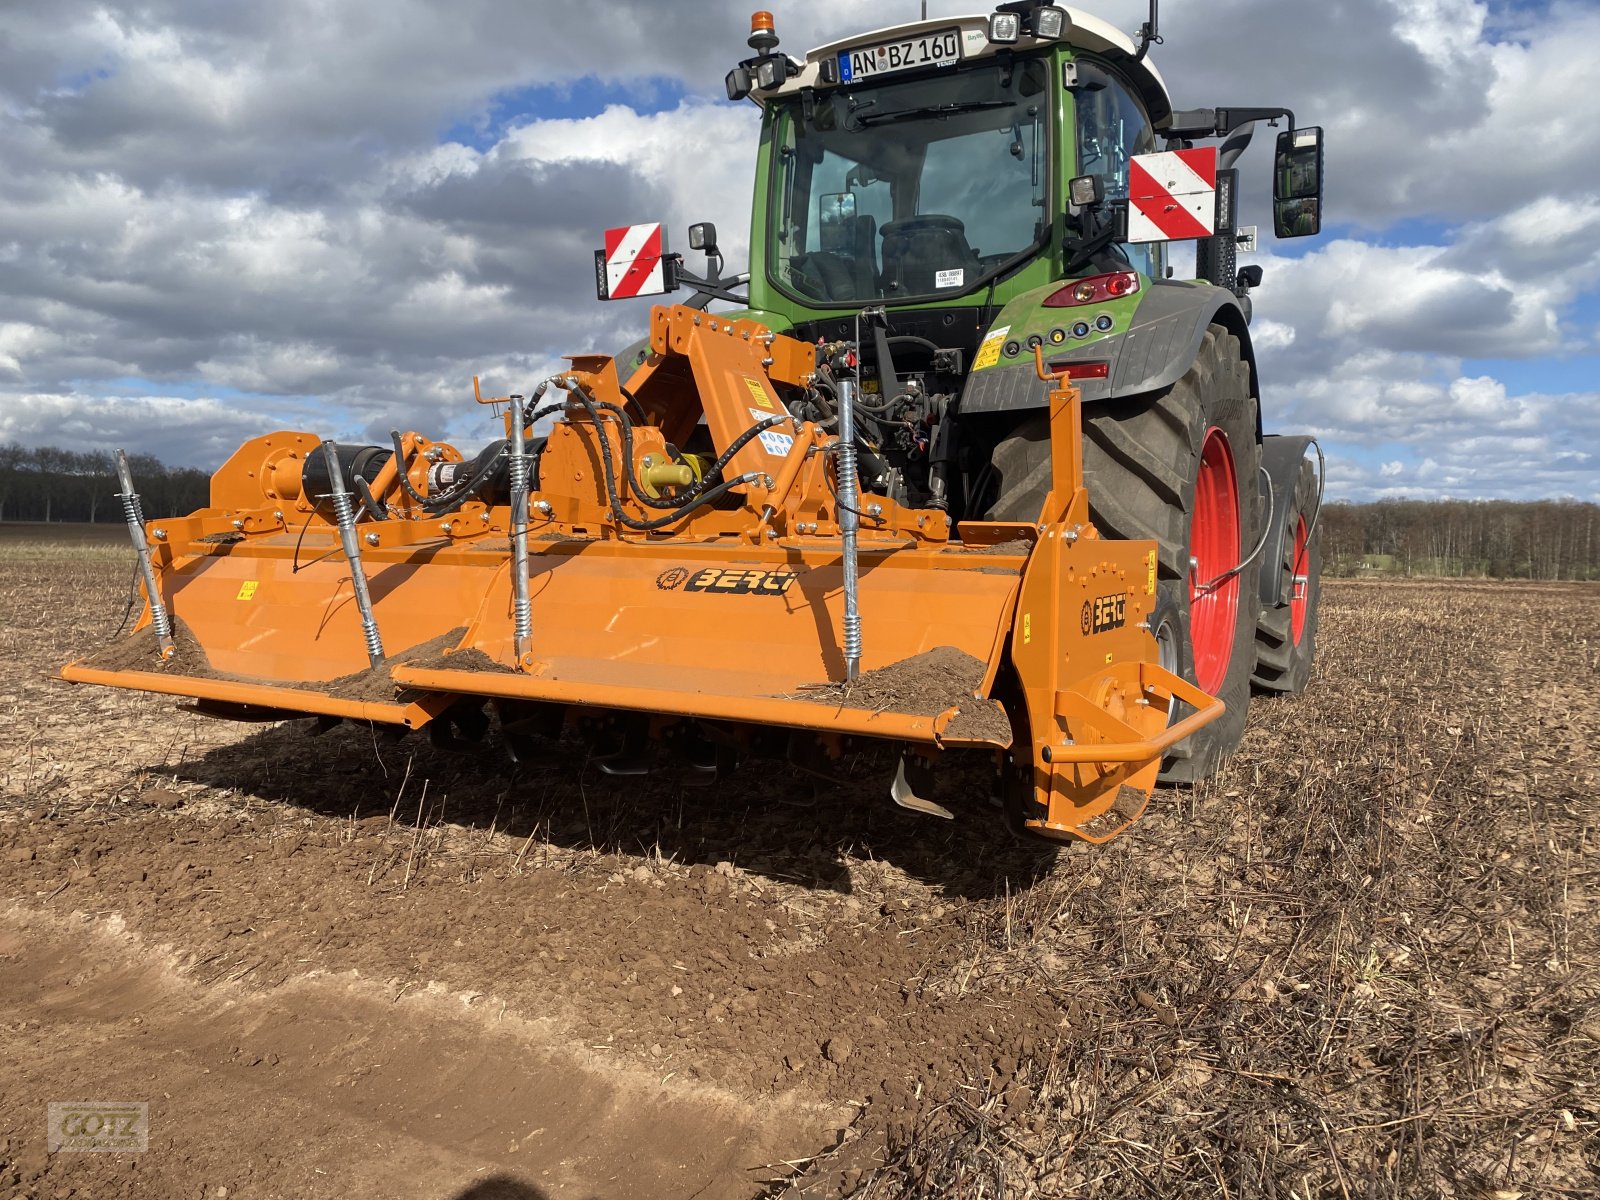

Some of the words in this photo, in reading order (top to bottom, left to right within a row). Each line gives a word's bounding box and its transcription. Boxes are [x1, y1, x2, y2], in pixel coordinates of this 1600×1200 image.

[852, 50, 877, 76] AN
[888, 42, 915, 68] BZ
[919, 34, 957, 62] 160
